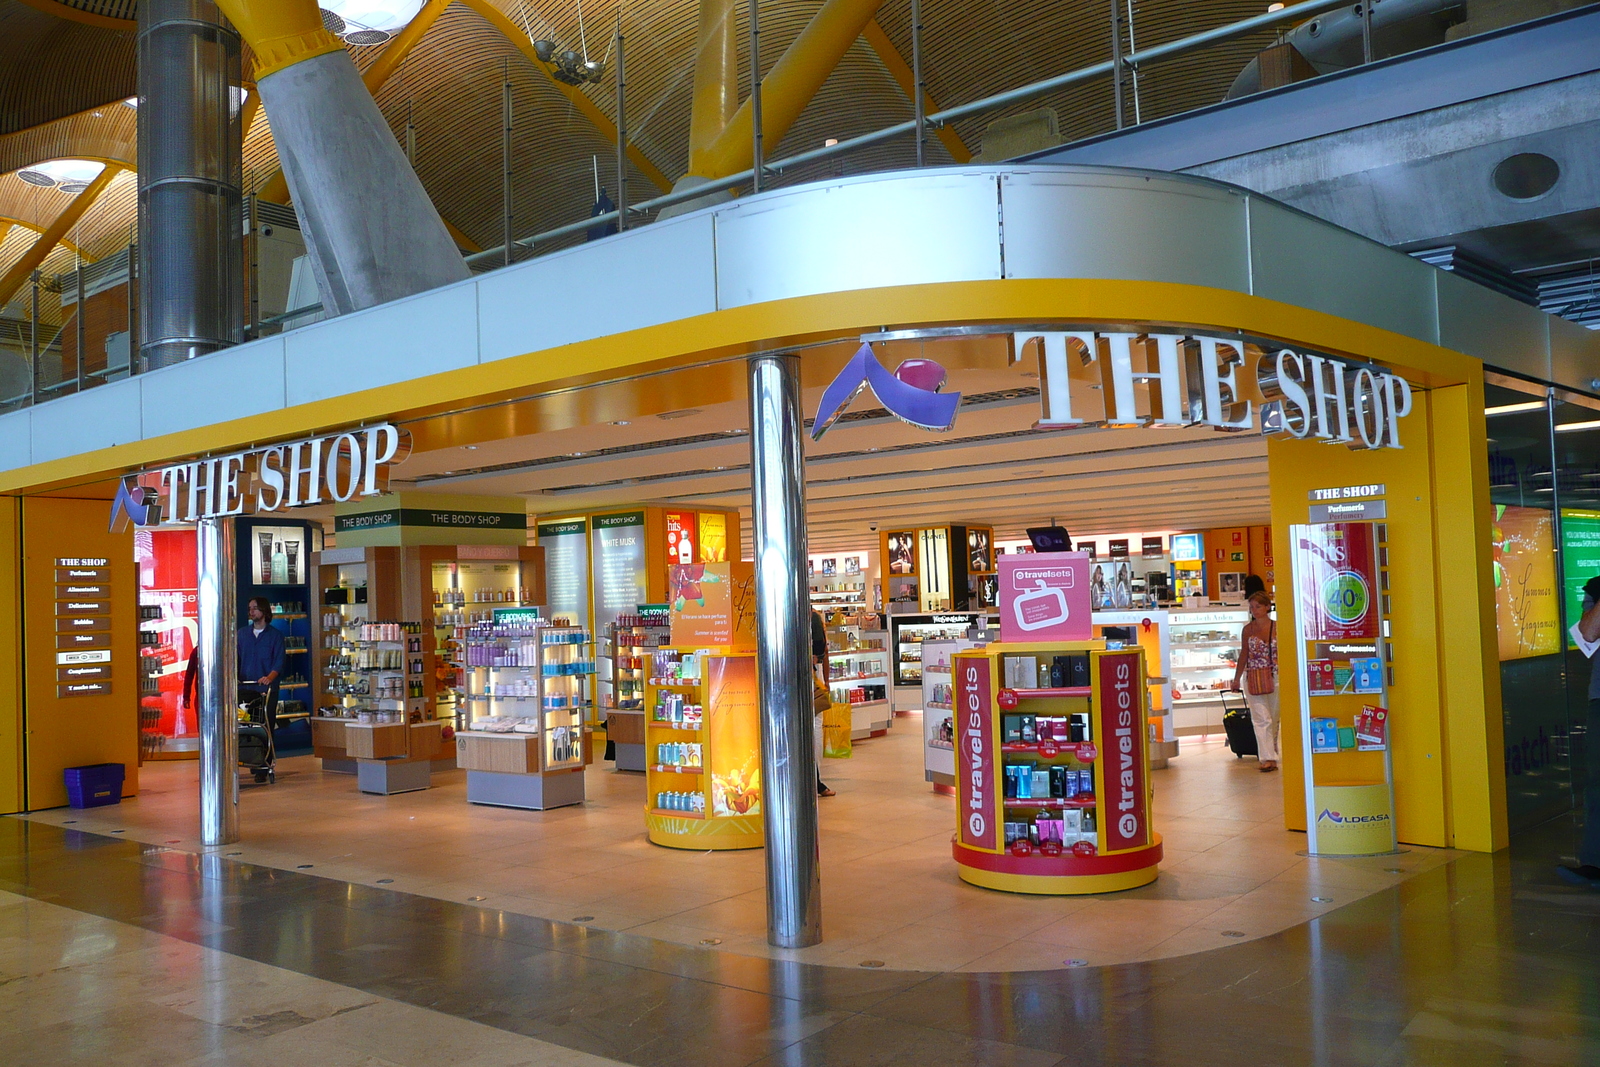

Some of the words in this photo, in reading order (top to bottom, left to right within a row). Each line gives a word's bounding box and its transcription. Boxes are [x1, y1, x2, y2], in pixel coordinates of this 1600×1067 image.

[1011, 330, 1252, 429] THE
[1277, 347, 1413, 450] SHOP
[162, 453, 246, 524] THE
[258, 423, 399, 512] SHOP
[1315, 487, 1340, 500] THE
[1343, 484, 1379, 498] SHOP
[1328, 502, 1365, 513] Perfumería
[342, 517, 355, 528] THE
[356, 515, 373, 526] BODY
[374, 513, 392, 524] SHOP
[431, 513, 449, 523] THE
[452, 515, 476, 524] BODY
[478, 515, 500, 525] SHOP
[1329, 512, 1365, 520] Perfumery
[667, 519, 681, 532] hits
[602, 538, 619, 548] WHITE
[620, 537, 637, 546] MUSK
[920, 533, 946, 541] CHANEL
[60, 558, 80, 566] THE
[81, 558, 107, 566] SHOP
[1025, 569, 1072, 579] travelsets
[1515, 562, 1552, 614] Summer
[1178, 613, 1212, 622] Elizabeth
[1213, 612, 1234, 621] Arden
[1328, 644, 1376, 654] Complementos
[1075, 661, 1085, 672] ck
[1311, 664, 1322, 672] hits
[1052, 668, 1061, 678] ck
[1003, 690, 1013, 698] hits
[1363, 707, 1374, 717] hits
[966, 666, 983, 810] travelsets
[1114, 663, 1136, 812] travelsets
[1044, 740, 1054, 748] hits
